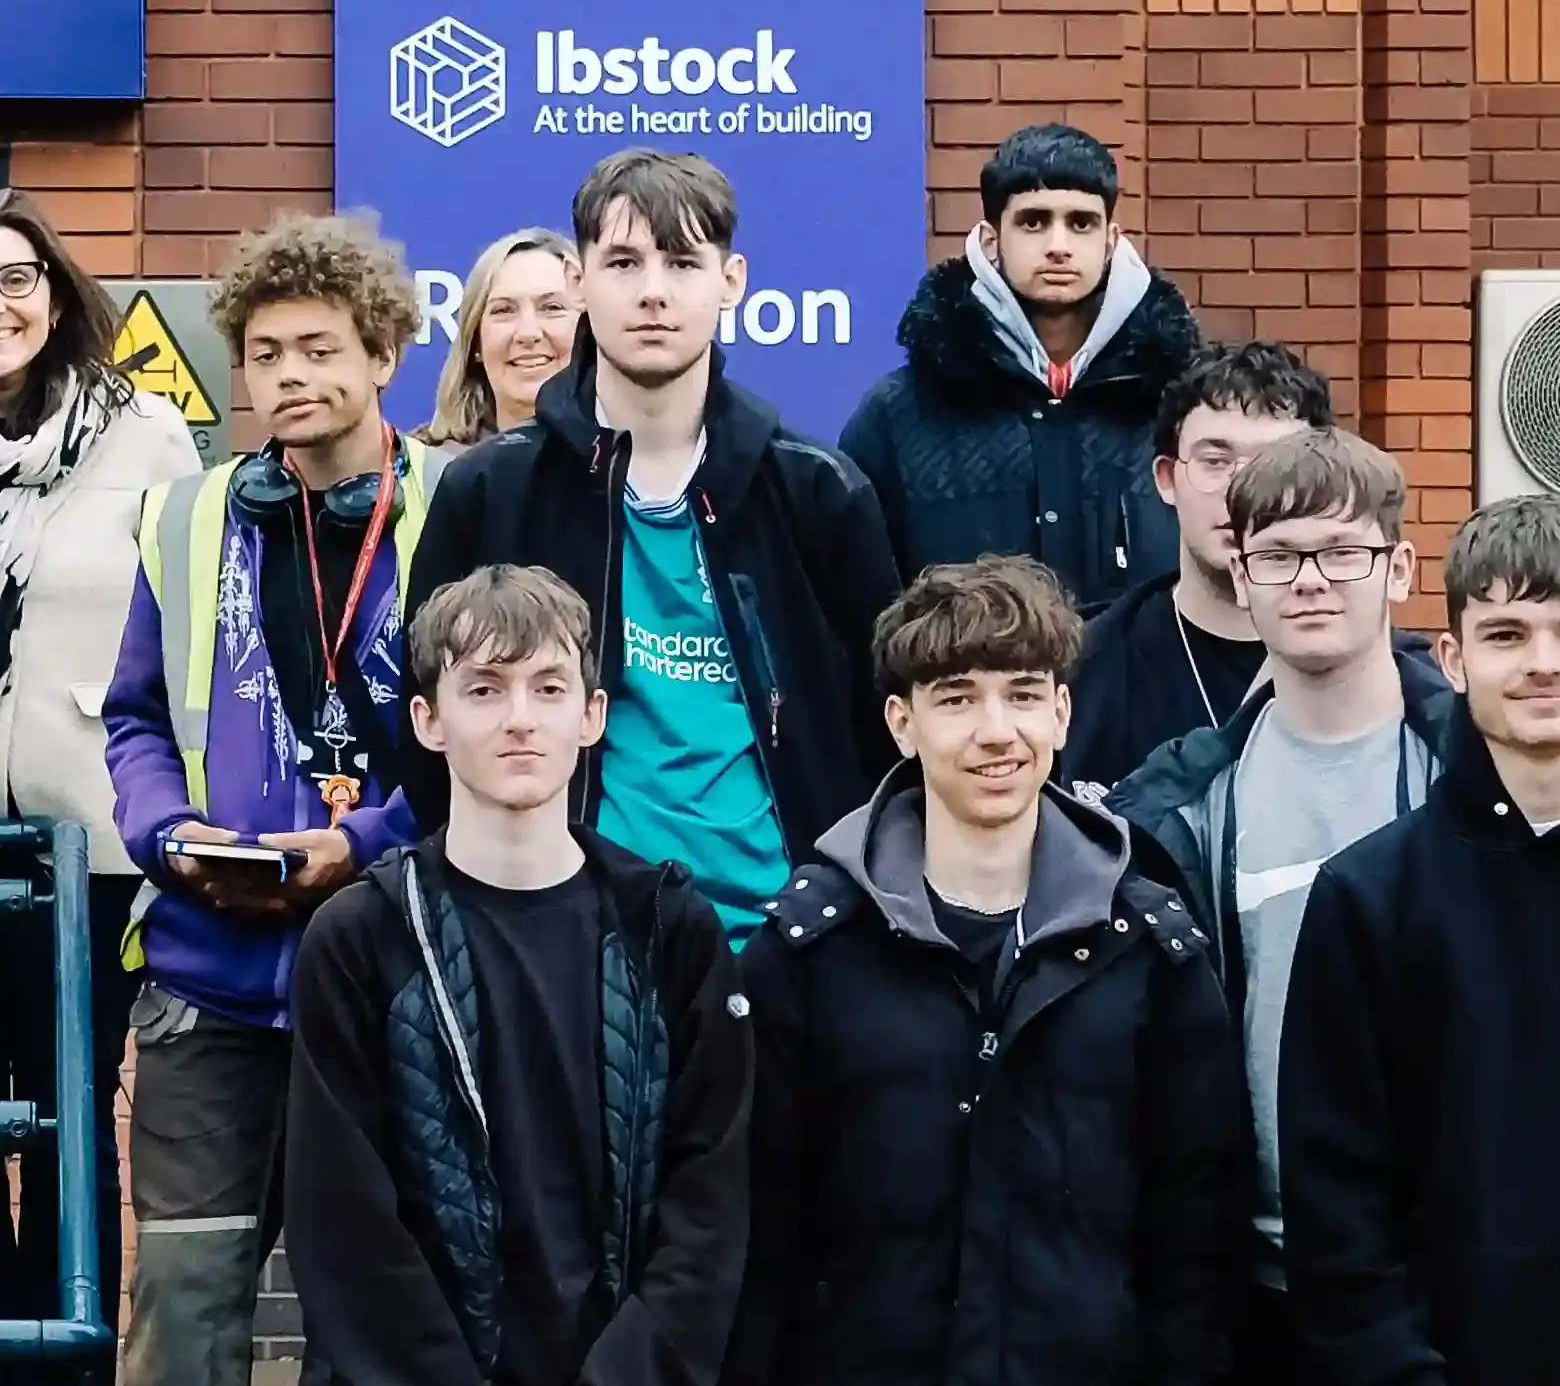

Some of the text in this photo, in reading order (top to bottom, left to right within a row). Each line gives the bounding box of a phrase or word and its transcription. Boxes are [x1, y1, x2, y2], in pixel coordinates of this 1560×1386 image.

[537, 29, 797, 94] Ibstock
[533, 102, 872, 141] At the heart of building
